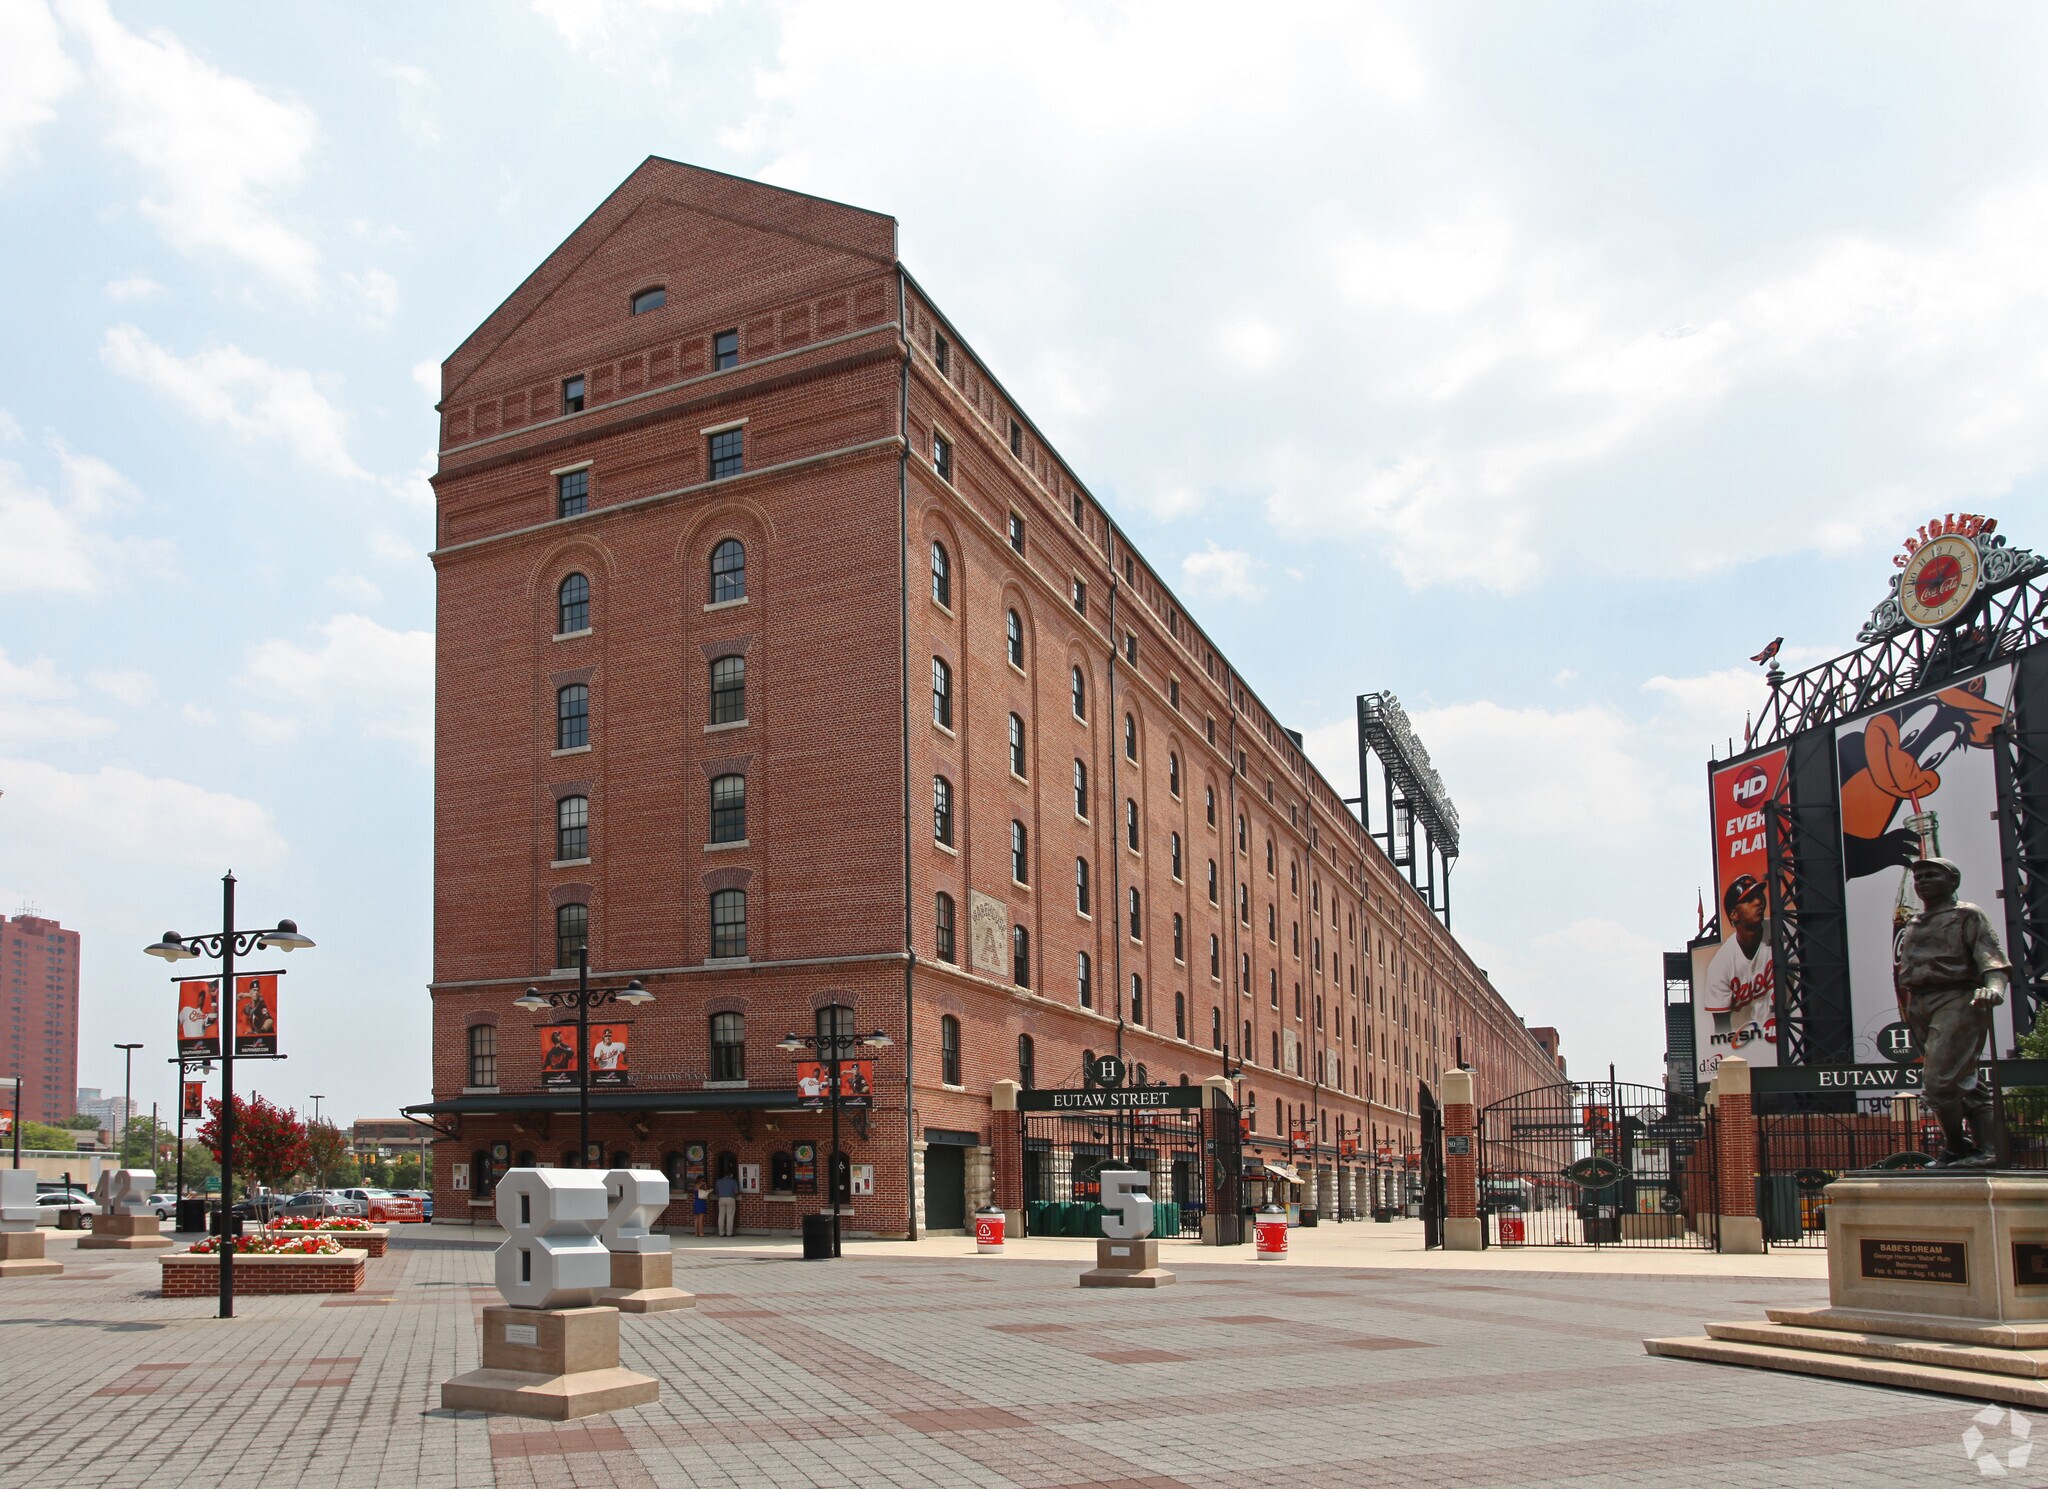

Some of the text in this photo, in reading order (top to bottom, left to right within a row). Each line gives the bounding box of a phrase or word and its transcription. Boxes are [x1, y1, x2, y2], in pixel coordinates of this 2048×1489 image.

[1733, 775, 1768, 802] HD
[1888, 1029, 1912, 1048] H
[1101, 1062, 1116, 1078] H
[1818, 1070, 1898, 1086] EUTAW
[1054, 1092, 1169, 1107] EUTAW STREET
[95, 1169, 140, 1215] 42
[1101, 1170, 1153, 1238] 5
[495, 1168, 588, 1309] 8
[1880, 1244, 1942, 1254] BABE'S DREAM
